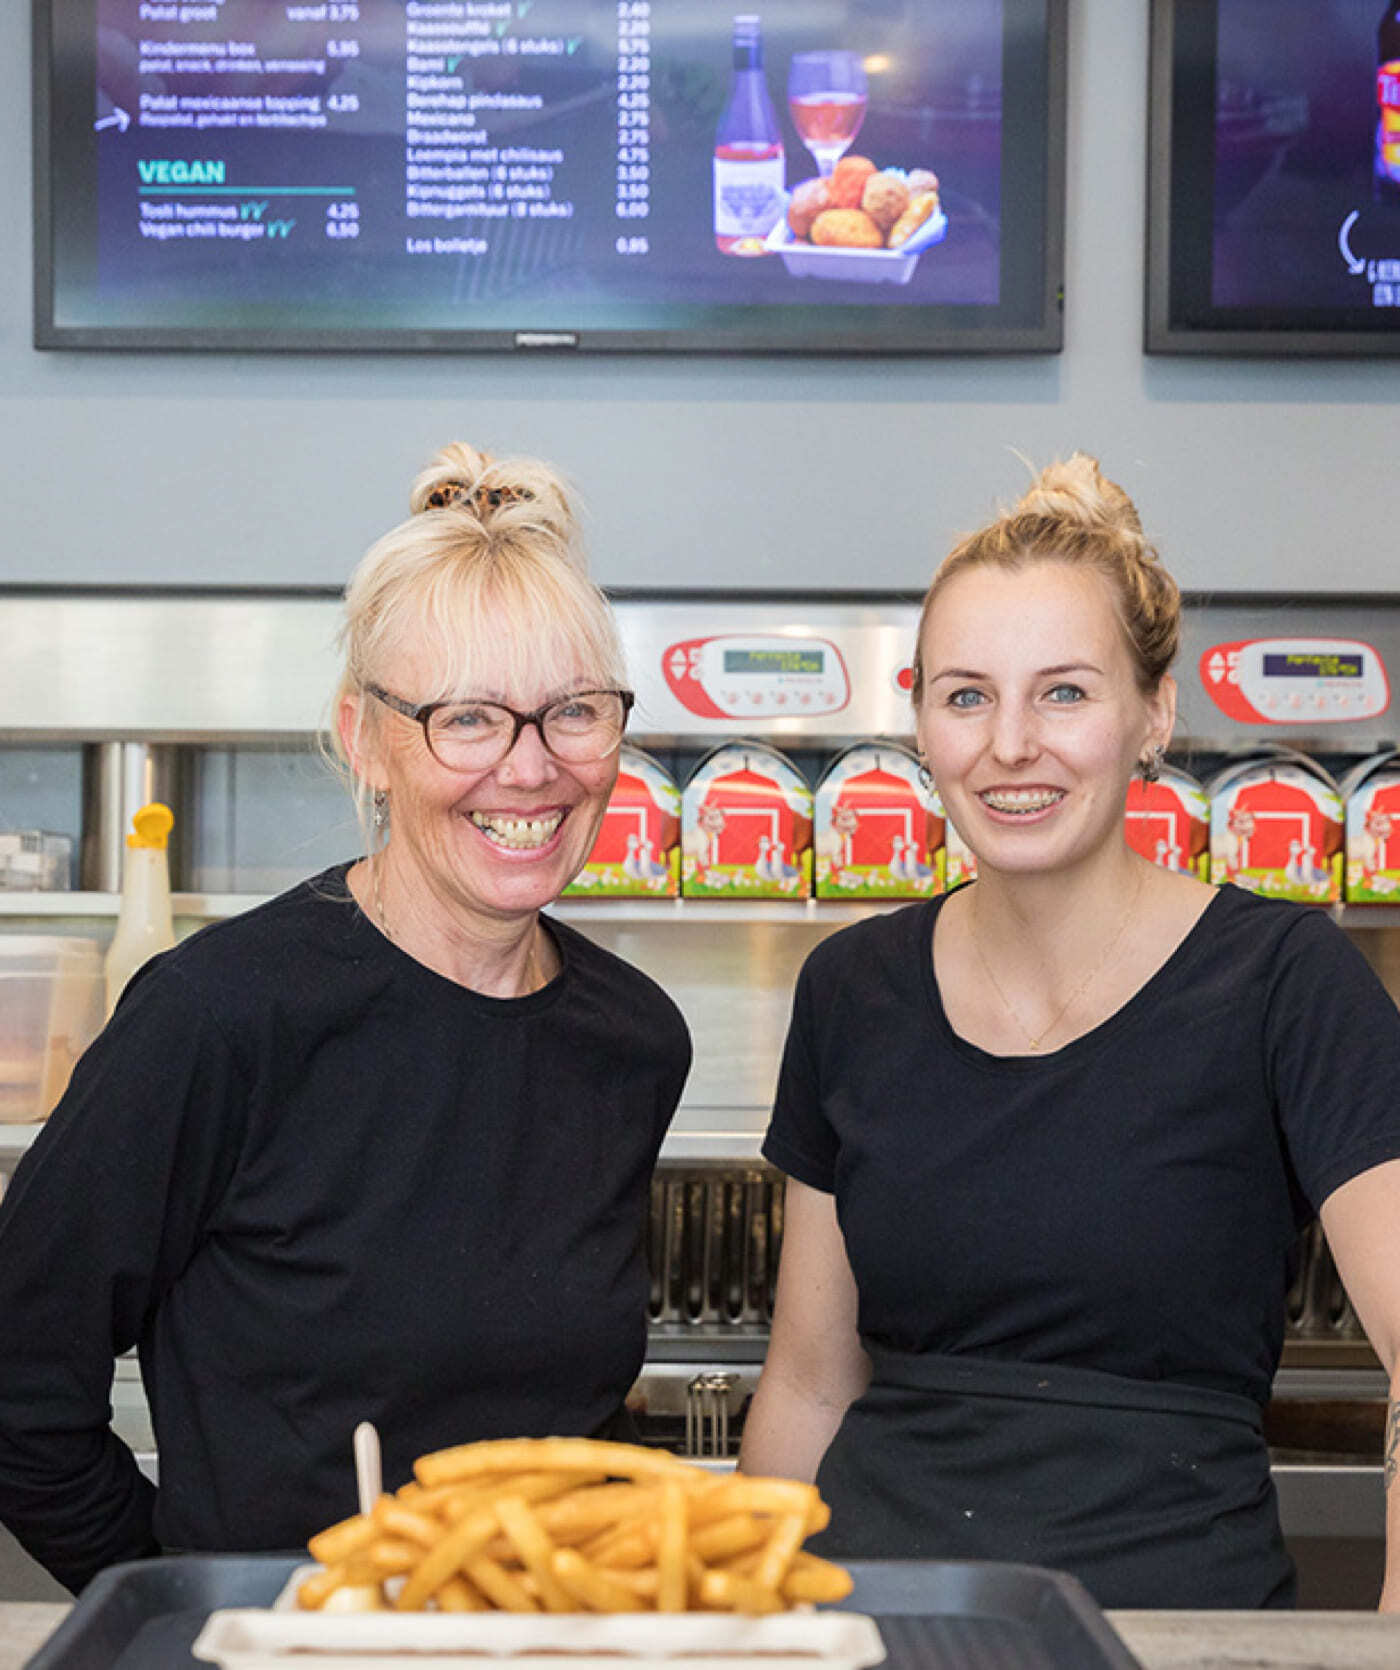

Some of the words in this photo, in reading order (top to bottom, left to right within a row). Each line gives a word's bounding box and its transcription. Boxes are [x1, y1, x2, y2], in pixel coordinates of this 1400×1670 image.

[140, 5, 177, 21] Patat
[179, 6, 216, 23] groot
[140, 41, 226, 56] Kindermenu
[229, 41, 256, 56] box
[519, 38, 565, 55] stuks)
[406, 56, 445, 73] Bami
[140, 94, 177, 110] Patat
[265, 95, 320, 112] topping
[406, 147, 467, 164] Loempia
[469, 148, 498, 163] met
[137, 160, 226, 184] VEGAN
[508, 165, 553, 181] stuks)
[506, 183, 551, 200] stuks)
[140, 202, 173, 219] Tosti
[176, 202, 238, 219] hummus
[528, 201, 574, 218] stuks)
[140, 220, 184, 240] Vegan
[218, 221, 265, 240] burger
[406, 238, 432, 253] Los
[434, 238, 487, 255] bolletje
